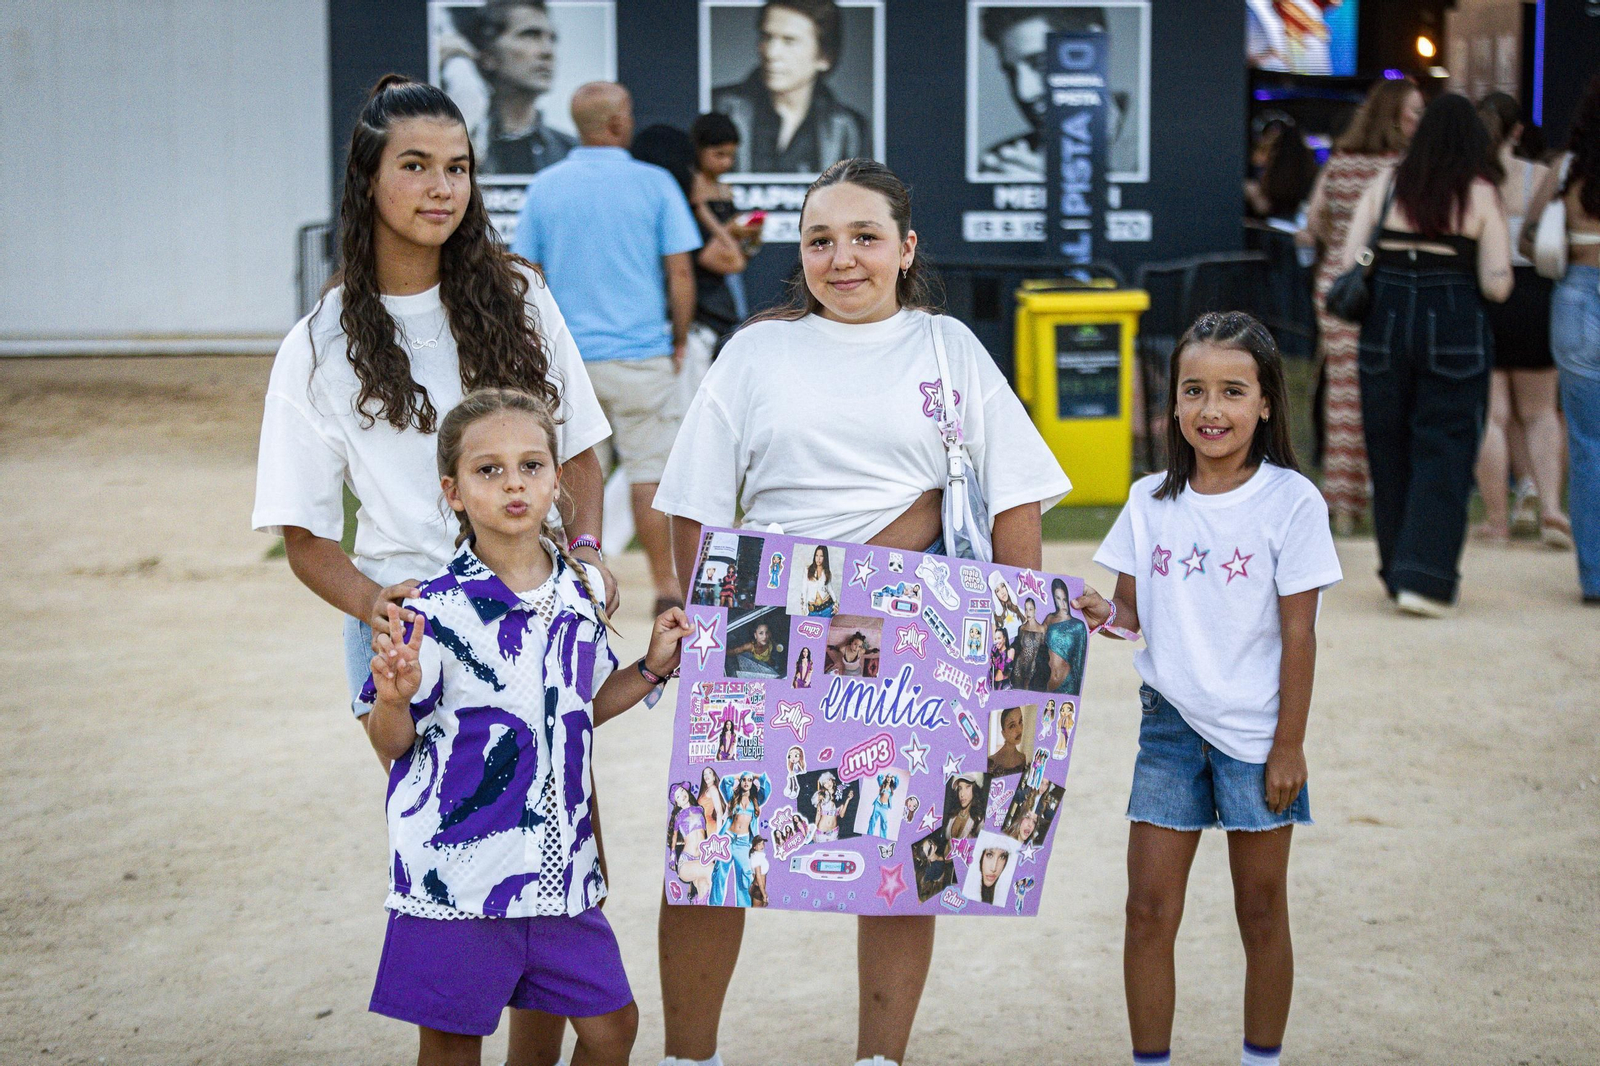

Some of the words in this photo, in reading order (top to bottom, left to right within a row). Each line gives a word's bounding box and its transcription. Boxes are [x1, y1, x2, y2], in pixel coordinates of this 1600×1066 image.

[1061, 112, 1093, 217] PISTA
[980, 600, 990, 608] SET
[820, 666, 950, 730] emilia
[844, 739, 890, 776] .mp3
